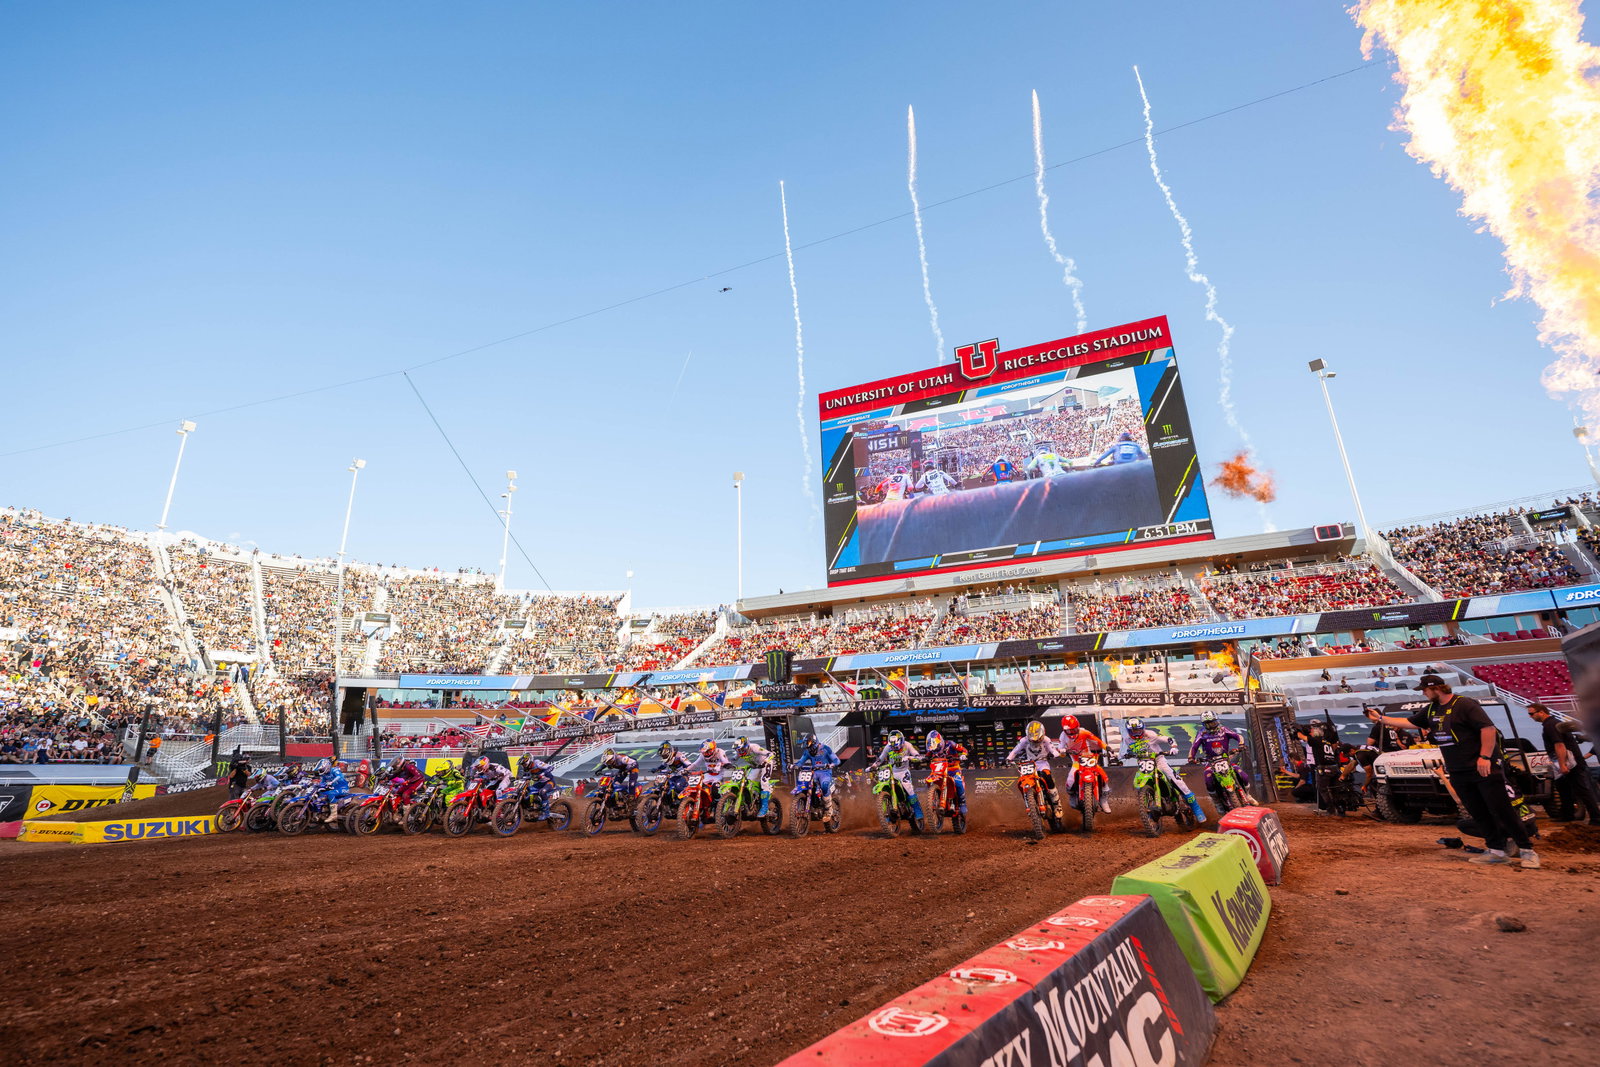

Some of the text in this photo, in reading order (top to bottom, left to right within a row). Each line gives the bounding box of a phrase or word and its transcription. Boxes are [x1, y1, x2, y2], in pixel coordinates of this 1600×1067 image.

[1004, 326, 1163, 371] RICE-ECCLES STADIUM
[955, 338, 1000, 380] U
[825, 373, 953, 409] UNIVERSITY OF UTAH
[1144, 522, 1198, 539] 6:51 PM
[959, 573, 976, 583] Ken
[1002, 567, 1020, 578] Red
[1022, 565, 1045, 577] Zone
[1171, 625, 1245, 640] #DROPTHEGATE
[884, 651, 942, 664] #DROPTHEGATE
[426, 678, 481, 687] #DROPTHEGATE
[757, 684, 797, 694] MONSTER
[909, 685, 962, 697] MONSTER
[761, 708, 796, 716] Championship
[915, 715, 960, 723] Championship
[1079, 757, 1097, 767] 30
[1139, 761, 1155, 772] 36
[1214, 762, 1229, 772] 63
[1020, 764, 1035, 774] 65
[688, 776, 701, 784] 23
[732, 770, 744, 780] 56
[799, 772, 812, 781] 66
[878, 770, 891, 780] 98
[103, 820, 211, 841] SUZUKI
[1211, 858, 1265, 956] Kawasaki
[1033, 937, 1142, 1067] MOUNTAIN
